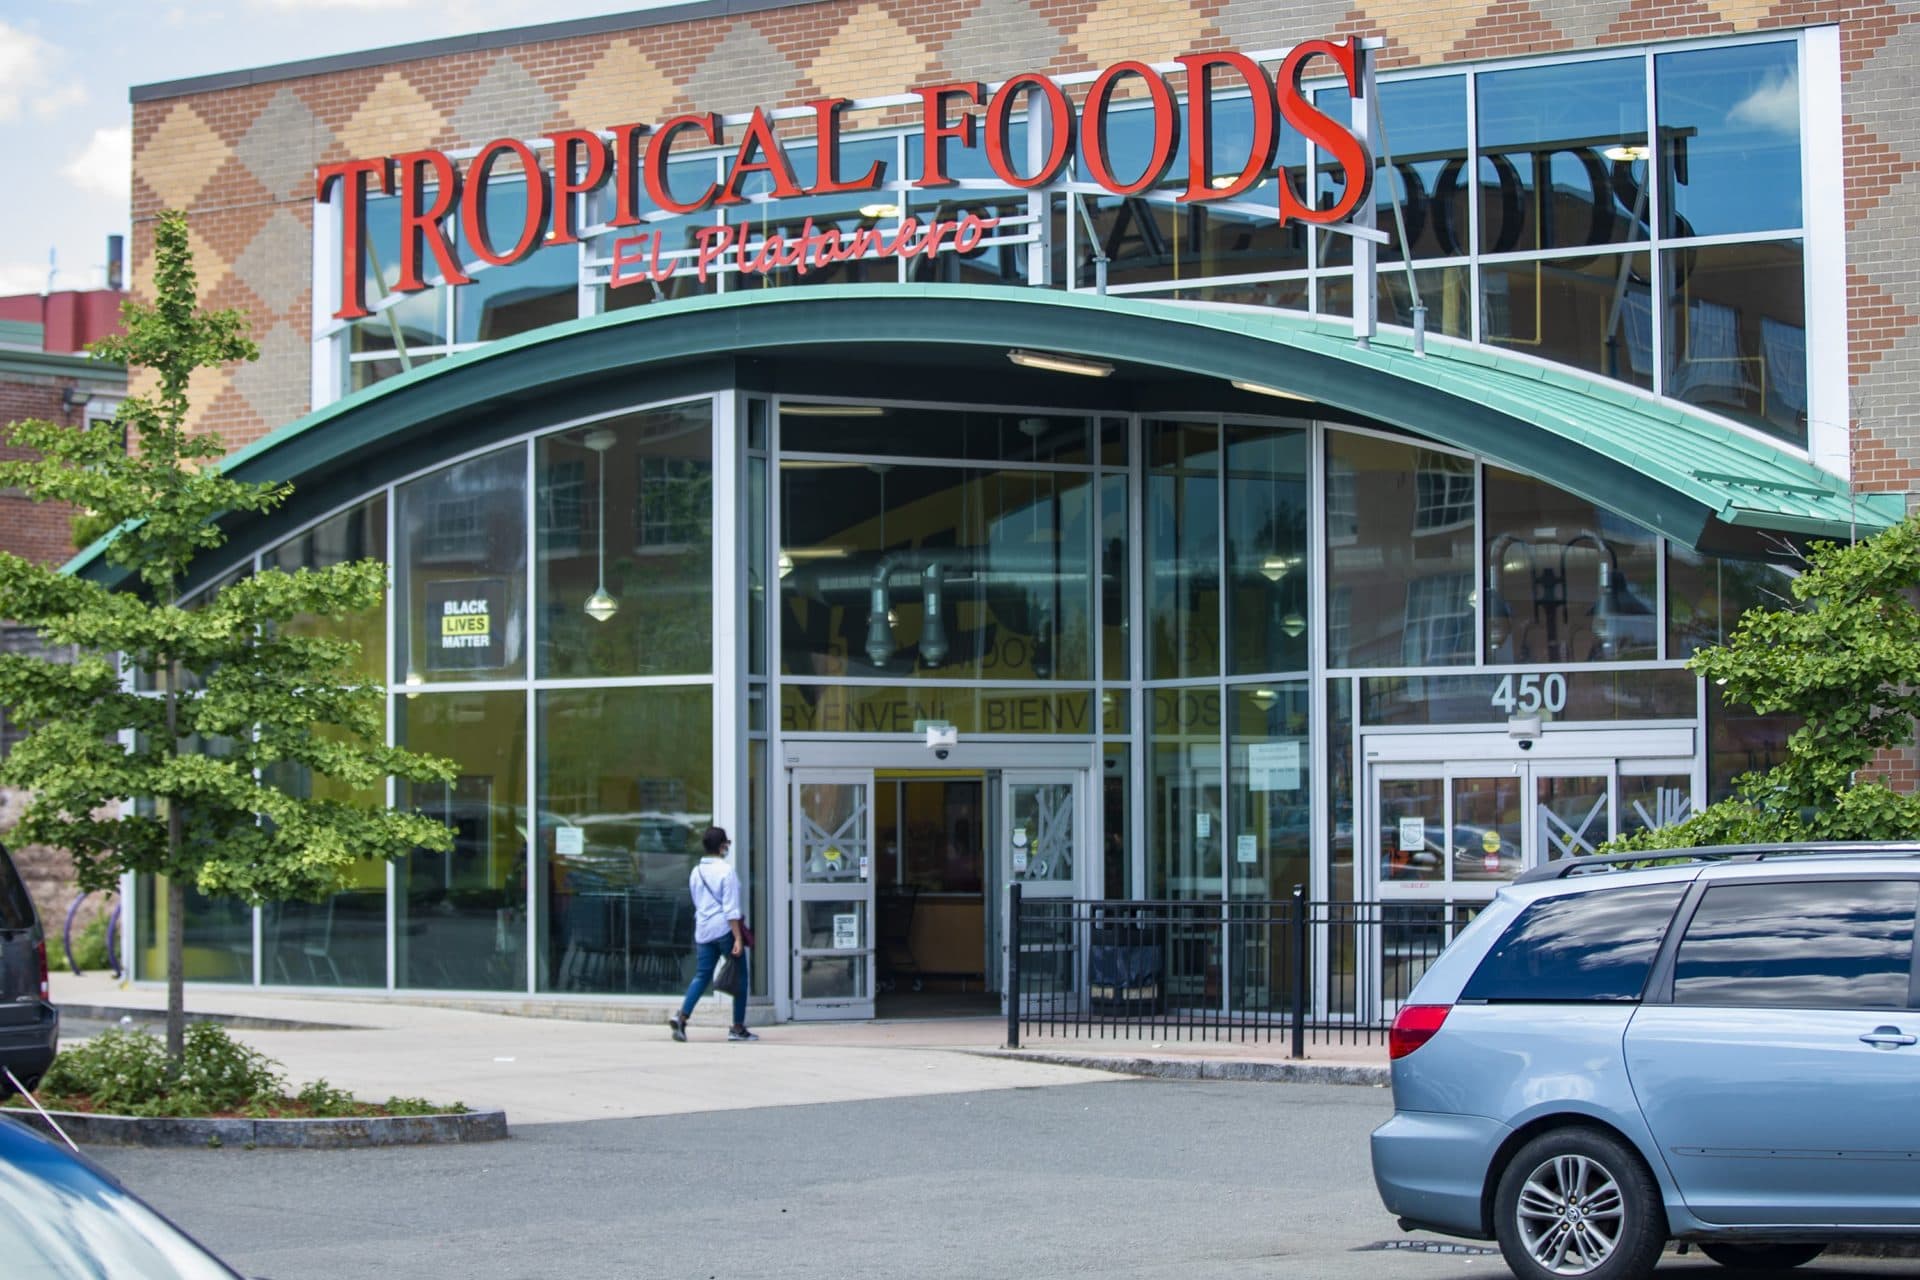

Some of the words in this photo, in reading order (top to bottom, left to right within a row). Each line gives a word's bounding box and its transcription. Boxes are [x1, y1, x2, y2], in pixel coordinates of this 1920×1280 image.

[316, 98, 885, 319] TROPICAL
[911, 35, 1372, 228] FOODS
[696, 214, 1000, 284] Platanero
[444, 599, 488, 615] BLACK
[446, 617, 485, 632] LIVES
[442, 634, 490, 648] MATTER
[1491, 672, 1567, 713] 450
